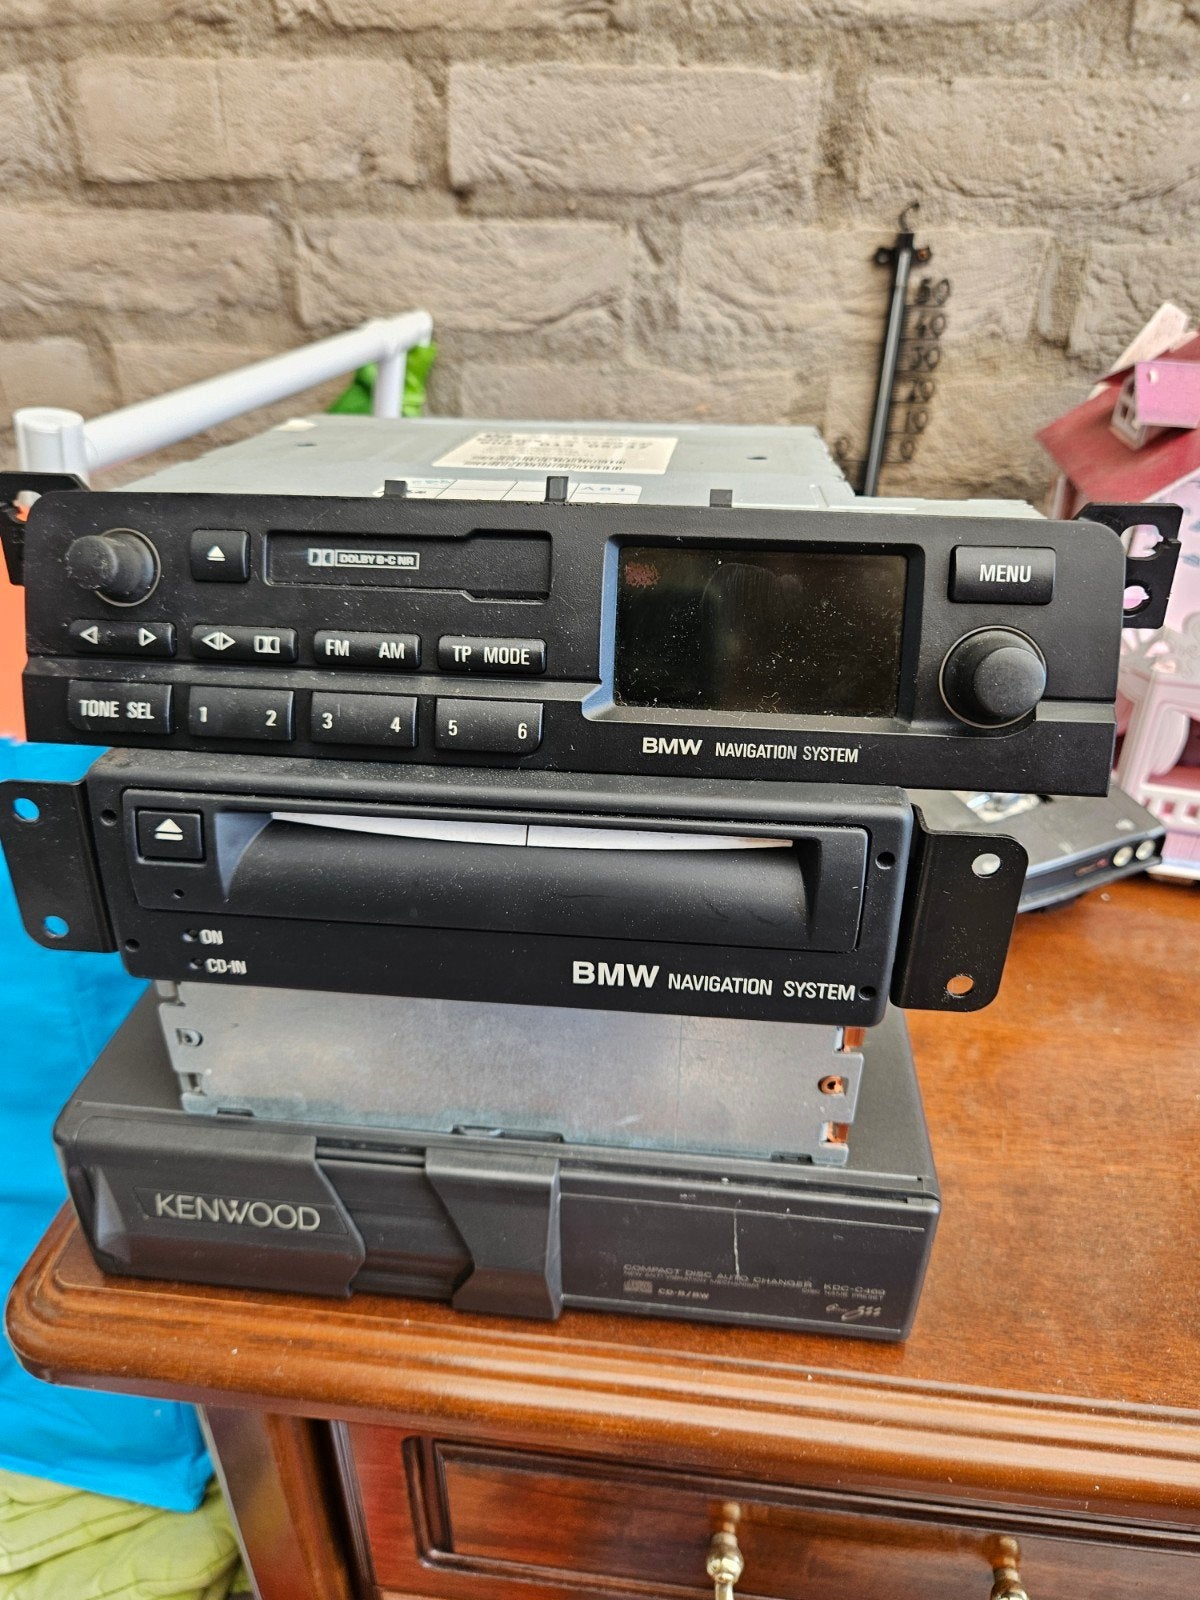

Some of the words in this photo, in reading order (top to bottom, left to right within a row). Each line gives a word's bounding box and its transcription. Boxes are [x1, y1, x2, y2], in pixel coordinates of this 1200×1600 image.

[339, 554, 375, 563] DOLBY
[397, 556, 414, 566] NR
[979, 563, 1032, 582] MENU
[326, 639, 350, 656] FM
[378, 641, 406, 658] AM
[451, 644, 473, 661] TP
[482, 645, 532, 664] MODE
[80, 700, 119, 717] TONE
[127, 702, 153, 719] SEL
[200, 707, 207, 722] 1
[266, 710, 276, 726] 2
[323, 713, 332, 728] 3
[391, 717, 400, 732] 4
[449, 720, 457, 735] 5
[518, 723, 527, 739] 6
[643, 737, 702, 755] BMW
[716, 743, 797, 759] NAVIGATION
[803, 746, 859, 762] SYSTEM
[200, 930, 223, 944] ON
[207, 959, 246, 974] CD-IN
[573, 961, 659, 987] BMW
[669, 974, 772, 995] NAVIGATION
[783, 981, 855, 1002] SYSTEM
[155, 1193, 320, 1231] KENWOOD
[623, 1263, 682, 1275] COMPACT
[685, 1270, 712, 1279] DISC
[717, 1273, 749, 1281] AUTO
[753, 1277, 812, 1288] CHANGER
